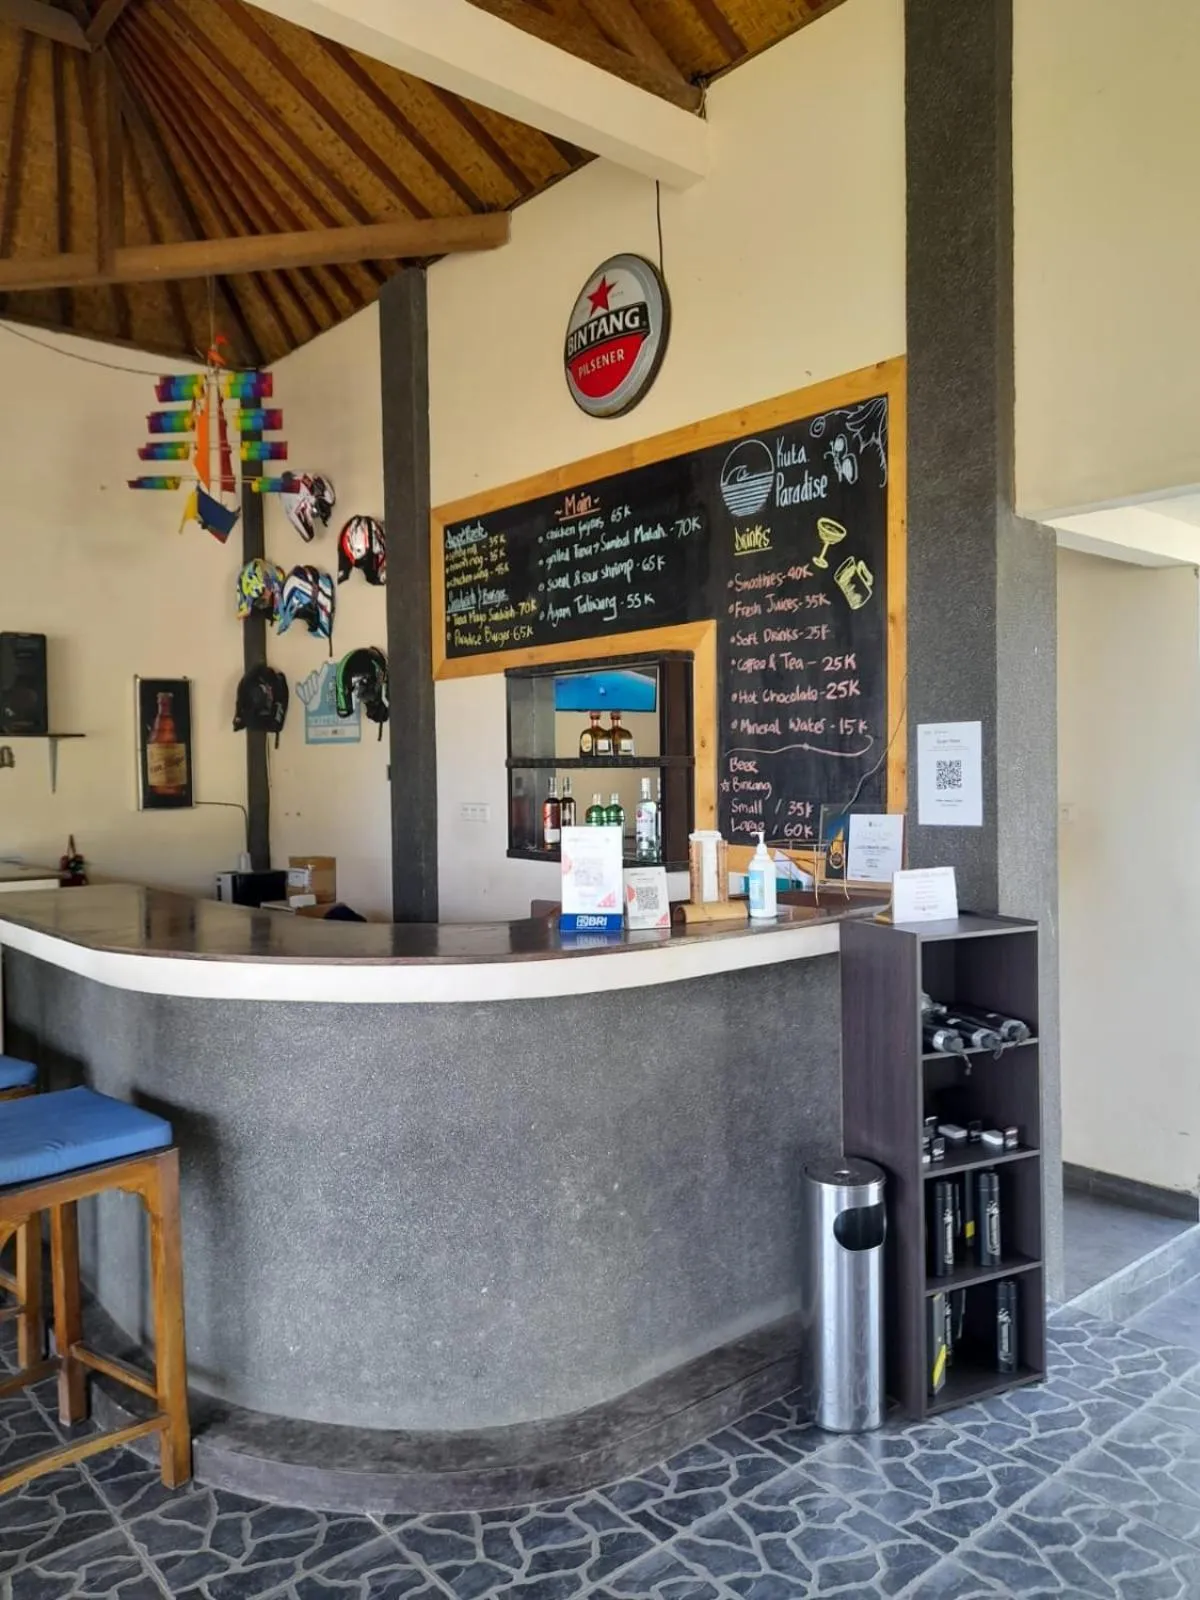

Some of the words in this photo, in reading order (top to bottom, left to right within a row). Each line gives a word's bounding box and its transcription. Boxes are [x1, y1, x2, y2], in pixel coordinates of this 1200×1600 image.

[567, 306, 640, 355] BINTANG
[577, 348, 625, 380] PILSENER
[776, 436, 806, 468] Kuta
[776, 470, 828, 507] Paradise
[565, 491, 592, 516] Main
[611, 504, 632, 522] 65K
[674, 516, 701, 538] 70K
[734, 525, 771, 550] Drinks
[601, 559, 633, 583] shrimp
[641, 555, 666, 571] 65K
[787, 564, 814, 580] 40K
[518, 597, 537, 616] 70K
[573, 594, 618, 621] Taliwang
[626, 593, 655, 609] 55K
[735, 601, 762, 618] Fresh
[805, 593, 831, 609] 35K
[513, 624, 534, 641] 65K
[736, 630, 759, 646] Soft
[737, 658, 767, 673] Coffee
[779, 651, 804, 670] Tea
[822, 653, 856, 672] 25K
[739, 689, 759, 704] Hot
[762, 684, 818, 704] Chocolate
[825, 679, 861, 700] 25K
[740, 718, 782, 735] Mineral
[839, 717, 868, 735] 15K
[729, 756, 759, 774] Beer
[732, 776, 772, 801] Bintang
[731, 798, 762, 815] Small
[787, 801, 814, 819] 35K
[783, 822, 814, 839] 60K
